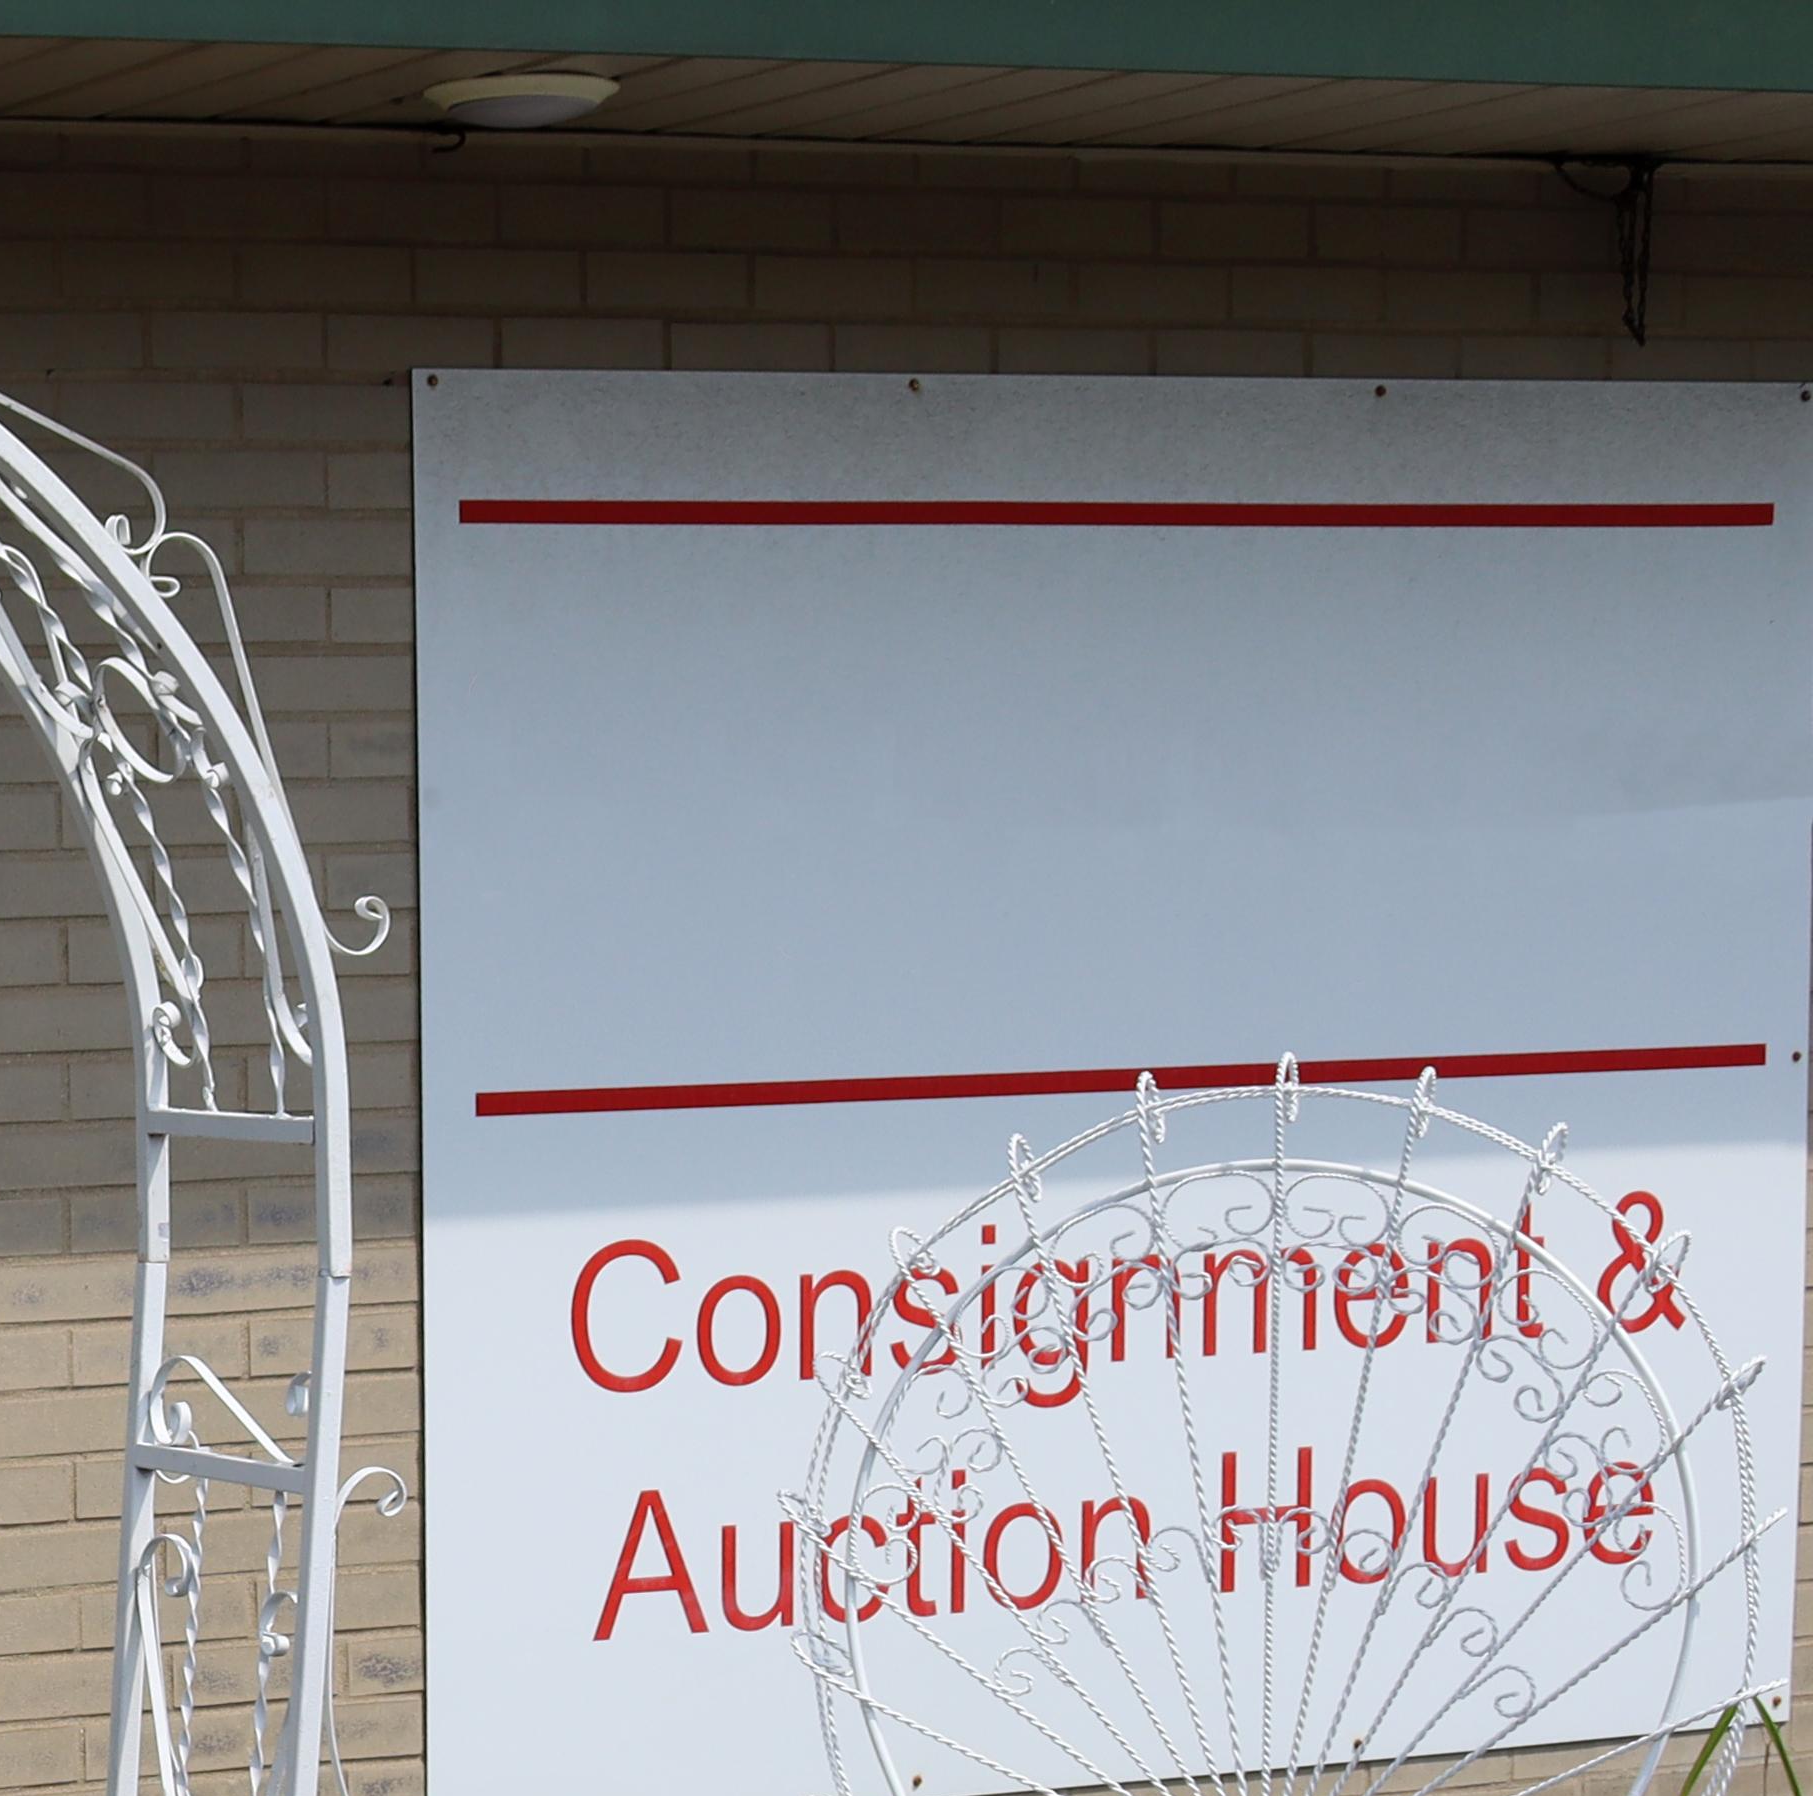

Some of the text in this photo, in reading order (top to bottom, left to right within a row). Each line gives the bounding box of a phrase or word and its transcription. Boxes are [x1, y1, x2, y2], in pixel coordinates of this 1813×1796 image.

[570, 1190, 1687, 1409] Consignment &
[594, 1446, 1657, 1641] Auction House
